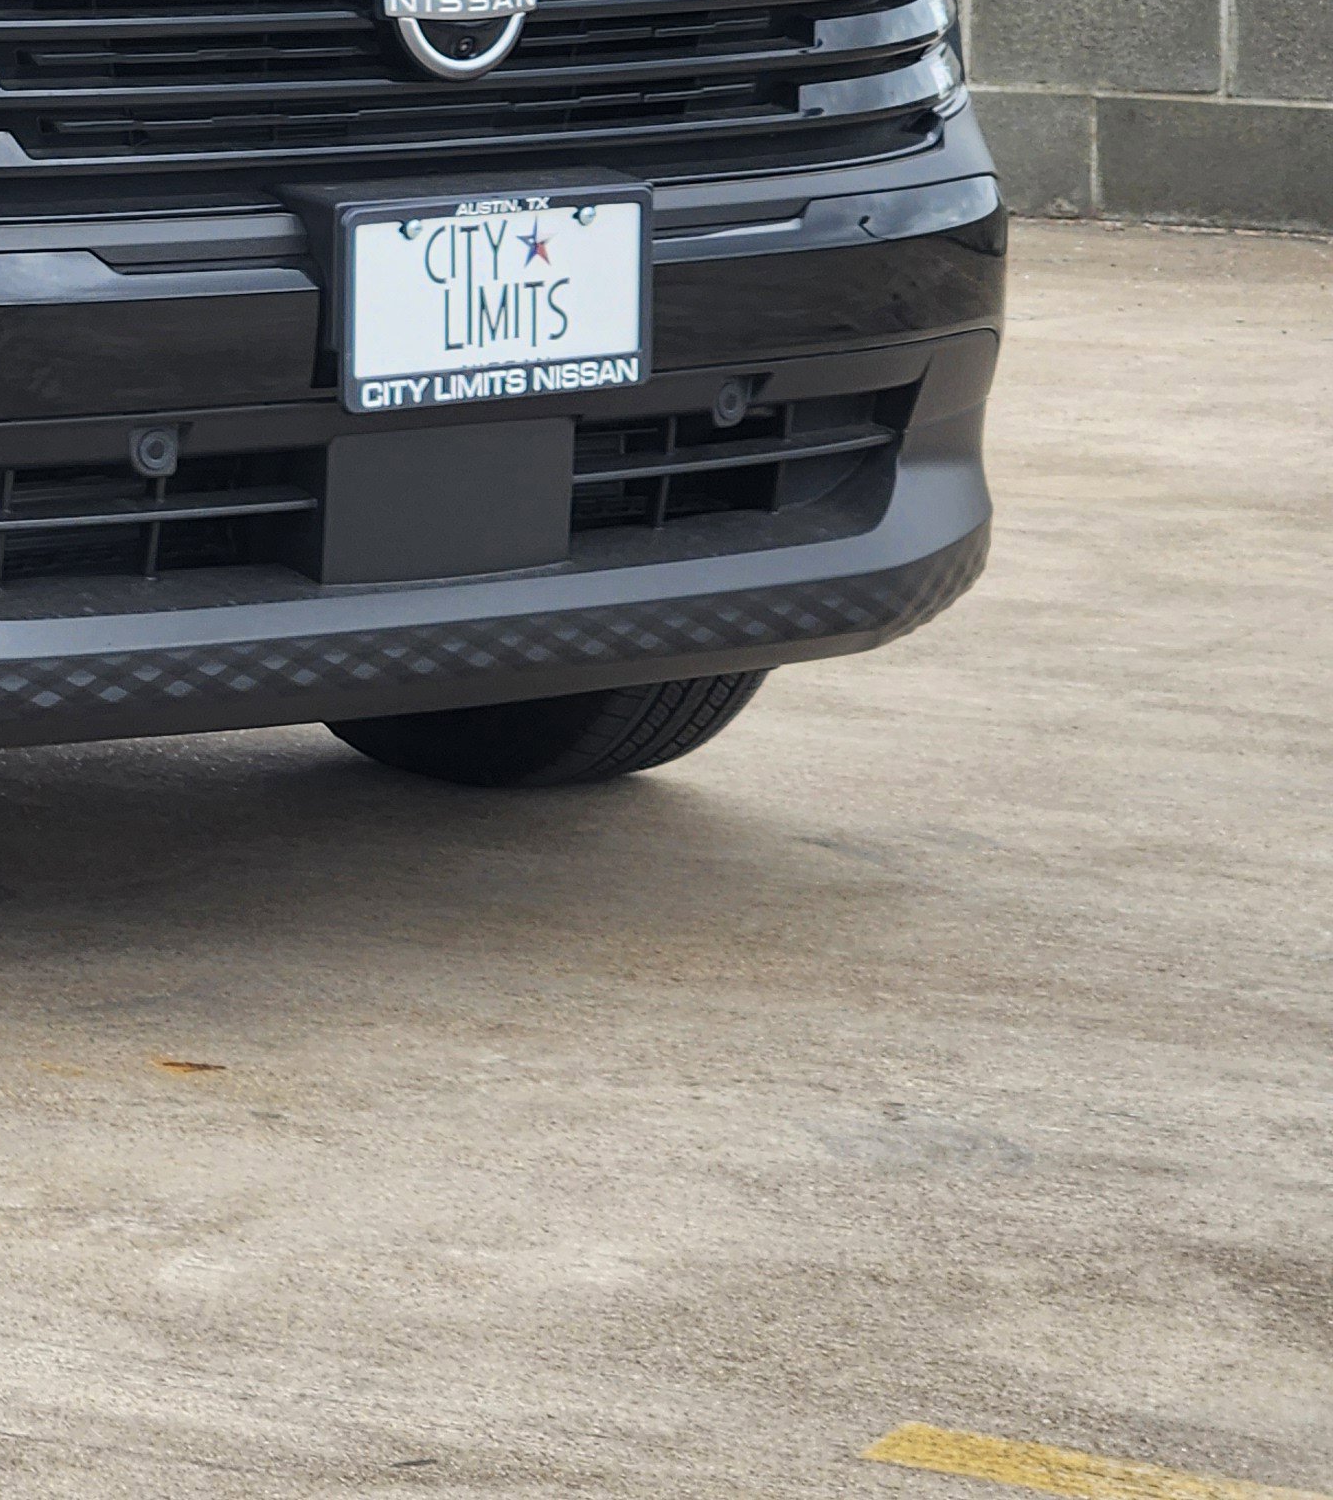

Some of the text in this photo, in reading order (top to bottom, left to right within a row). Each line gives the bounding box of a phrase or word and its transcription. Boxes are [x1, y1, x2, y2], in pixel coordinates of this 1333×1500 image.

[526, 196, 551, 211] TX
[424, 219, 508, 285] CITY
[444, 277, 571, 351] LIMITS
[361, 357, 640, 409] CITY LIMITS NISSAN
